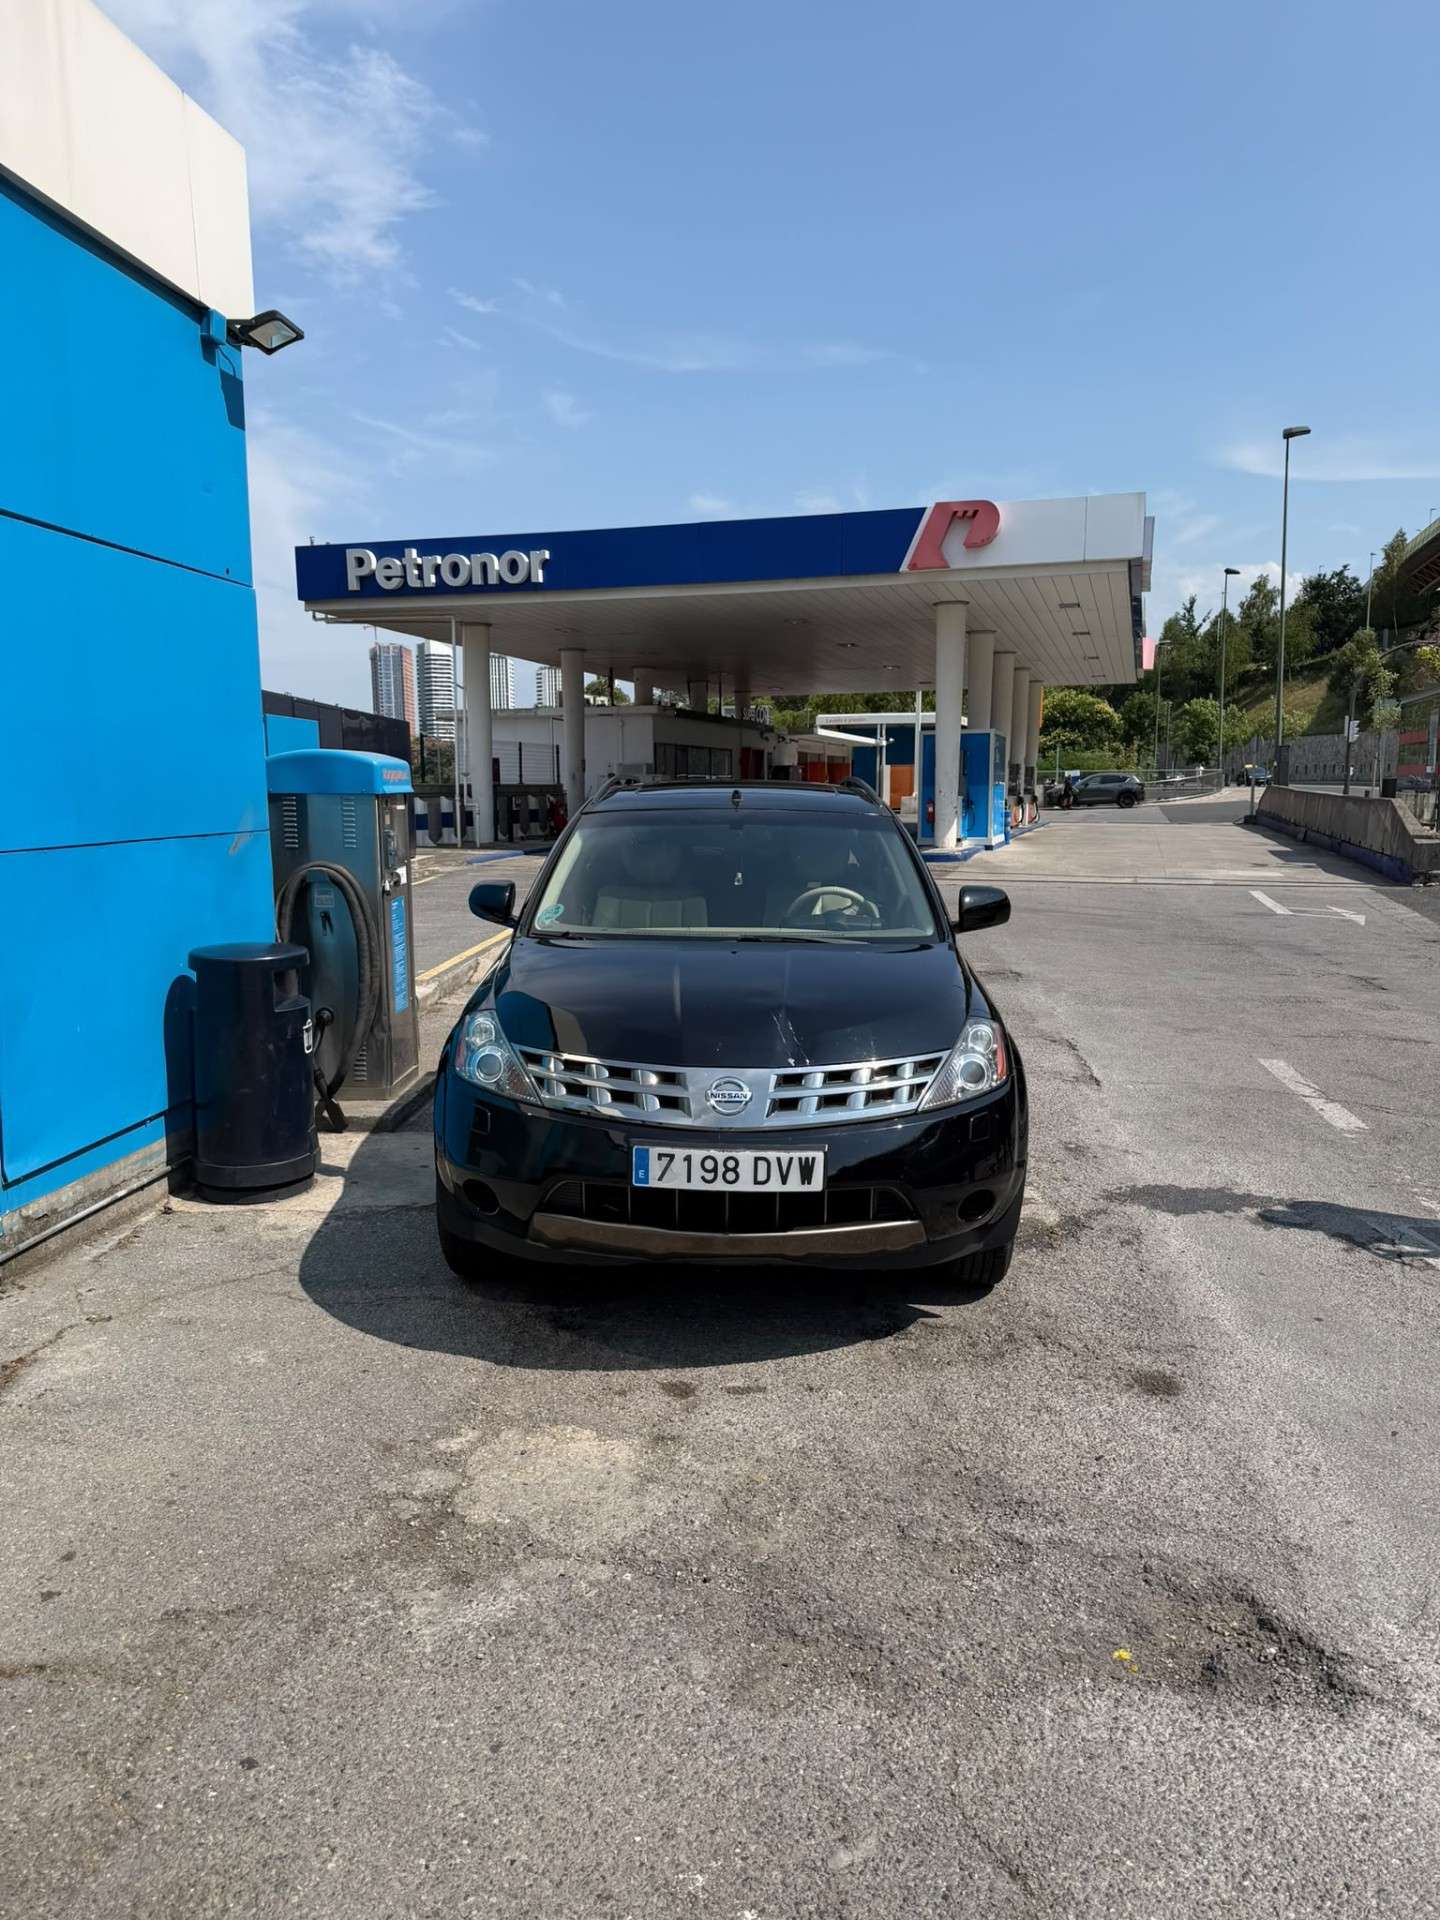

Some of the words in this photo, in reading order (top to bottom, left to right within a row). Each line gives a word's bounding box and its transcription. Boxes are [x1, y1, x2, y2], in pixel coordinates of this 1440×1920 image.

[346, 548, 550, 591] Petronor
[710, 1092, 748, 1100] NISSAN
[638, 1170, 645, 1178] E
[657, 1152, 740, 1184] 7198
[753, 1155, 816, 1186] DVW
